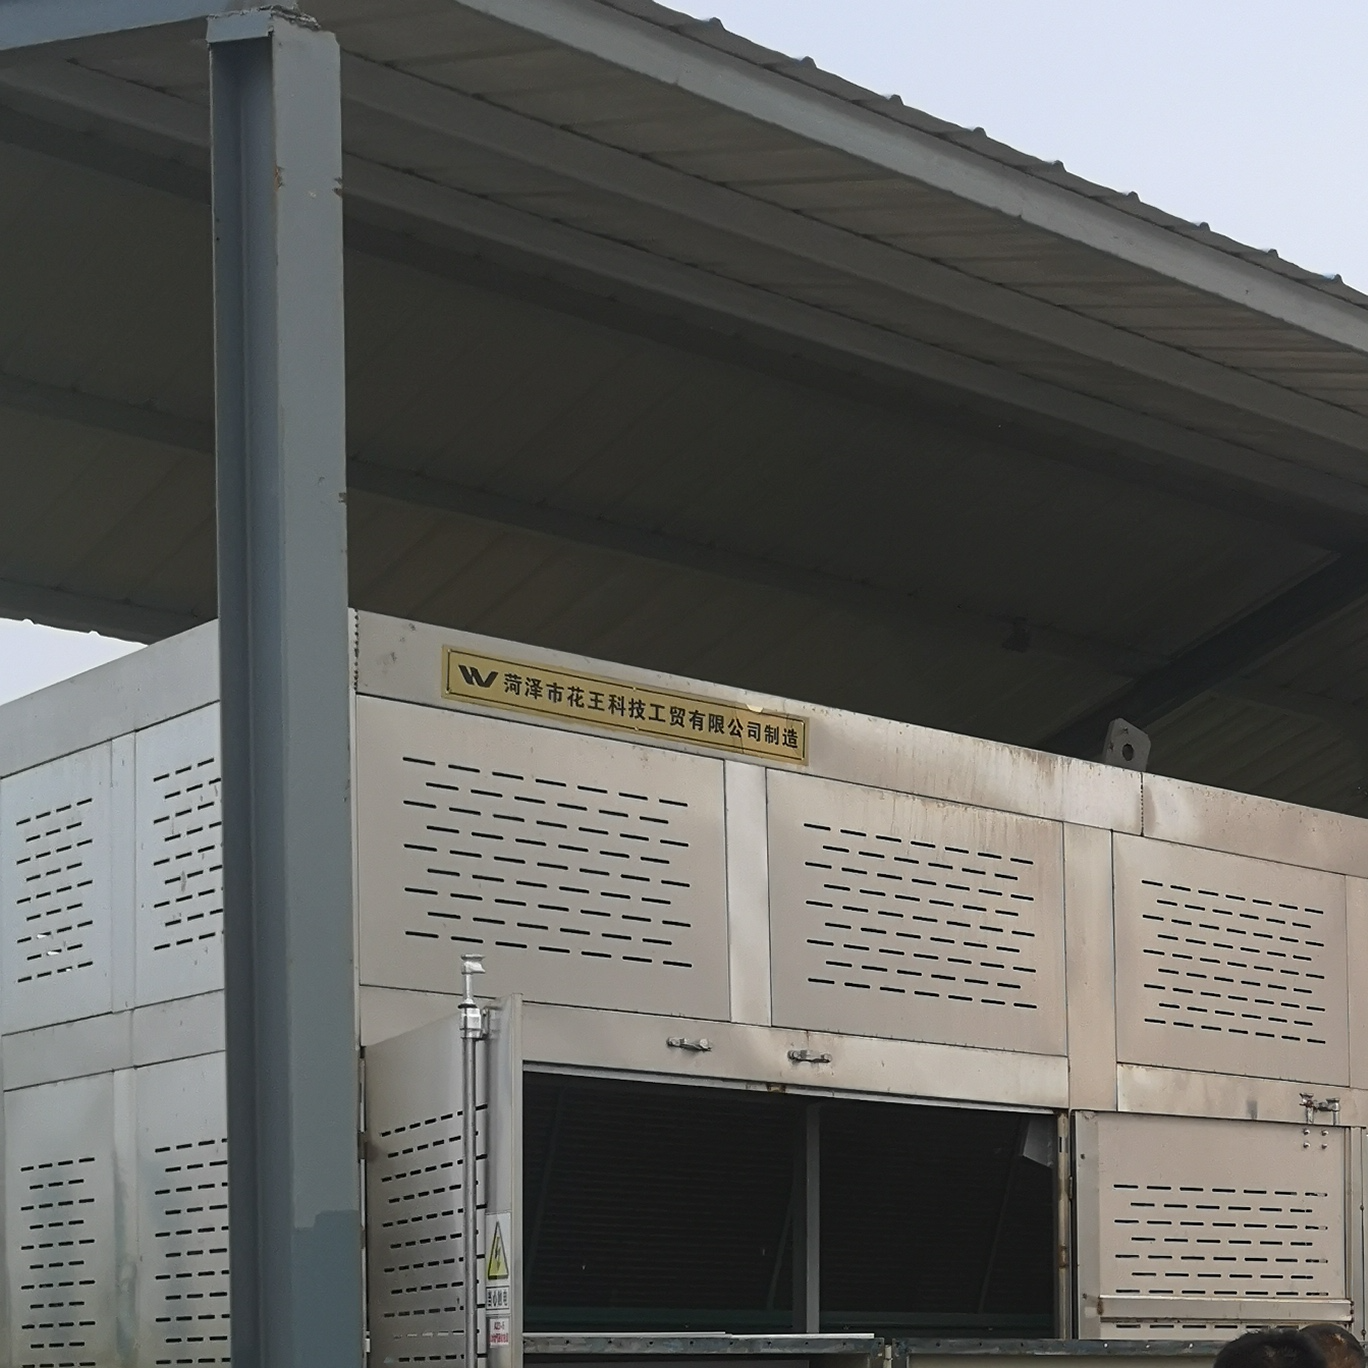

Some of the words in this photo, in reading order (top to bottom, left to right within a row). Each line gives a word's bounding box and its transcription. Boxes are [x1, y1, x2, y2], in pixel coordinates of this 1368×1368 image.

[503, 672, 800, 750] 菏泽市花王科技工贸有限公司制造
